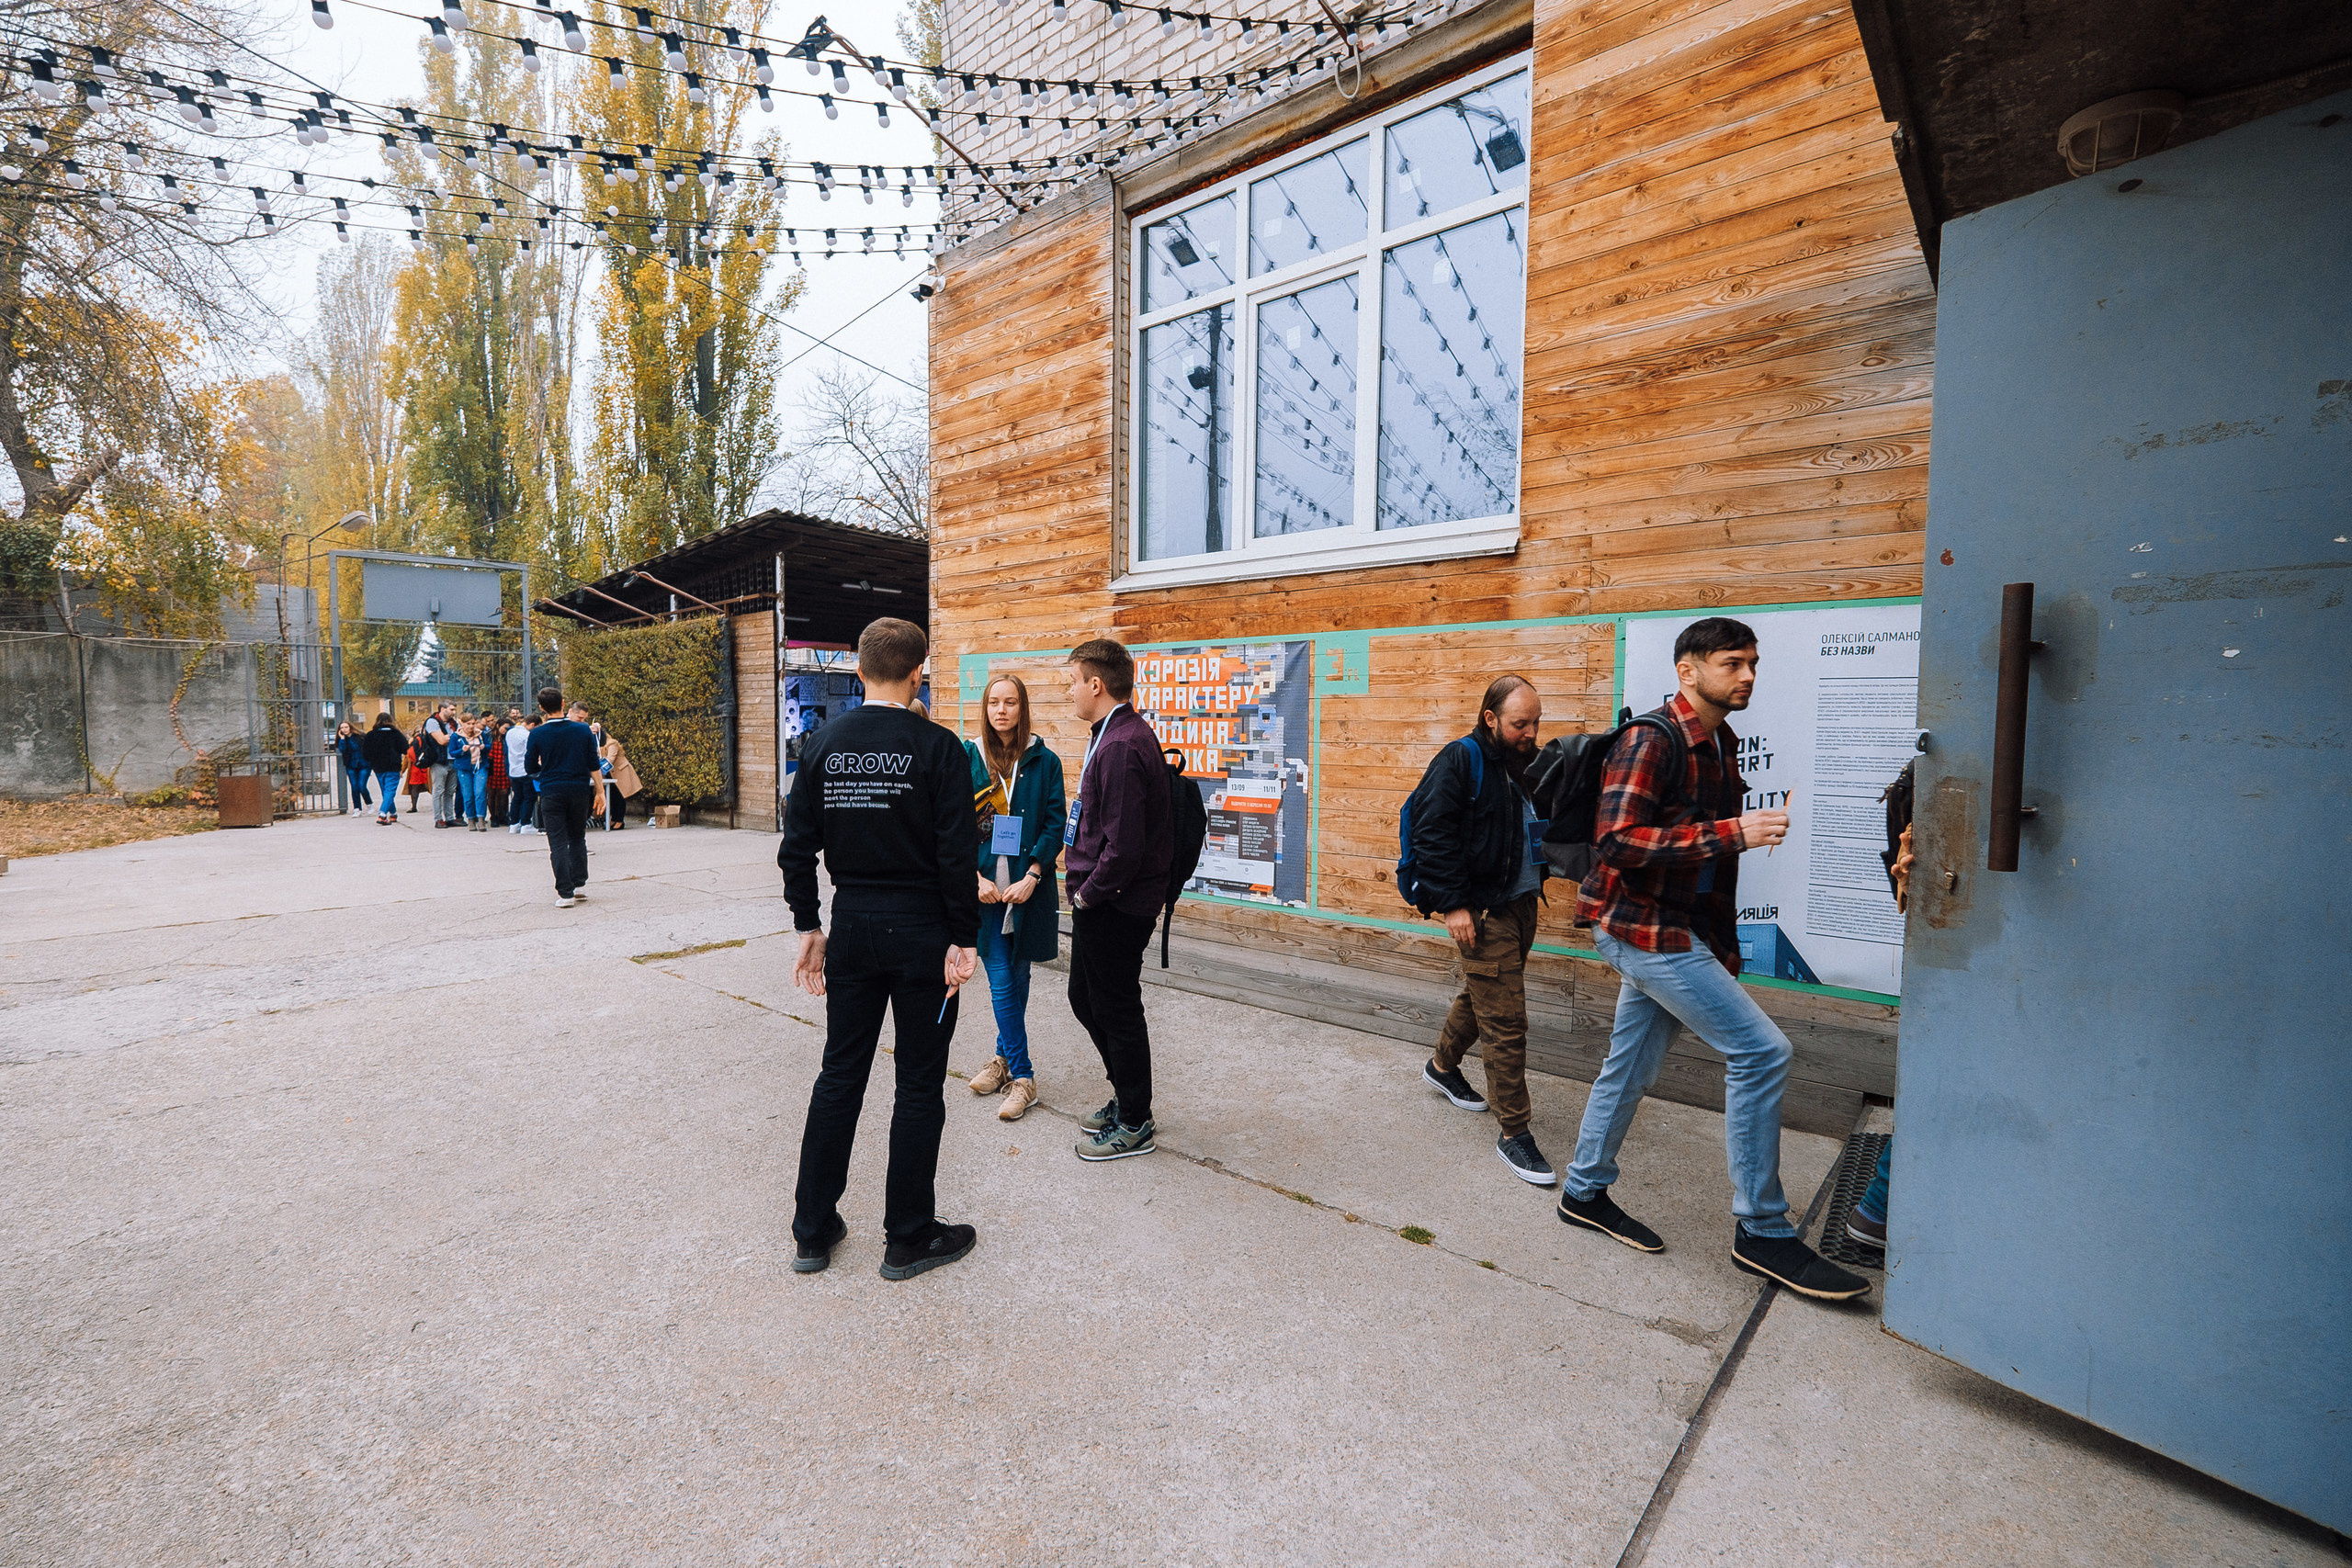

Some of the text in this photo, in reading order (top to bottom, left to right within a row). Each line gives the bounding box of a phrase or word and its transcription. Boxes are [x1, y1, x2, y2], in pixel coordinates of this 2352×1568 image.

[1821, 630, 1921, 644] ОЛЕКСІЙ САЛМАНО
[1821, 645, 1875, 657] БЕЗ НАЗВИ
[1136, 685, 1256, 710] ХАРАКТЕРУ
[825, 752, 913, 775] GROW
[1230, 784, 1246, 792] 13/09
